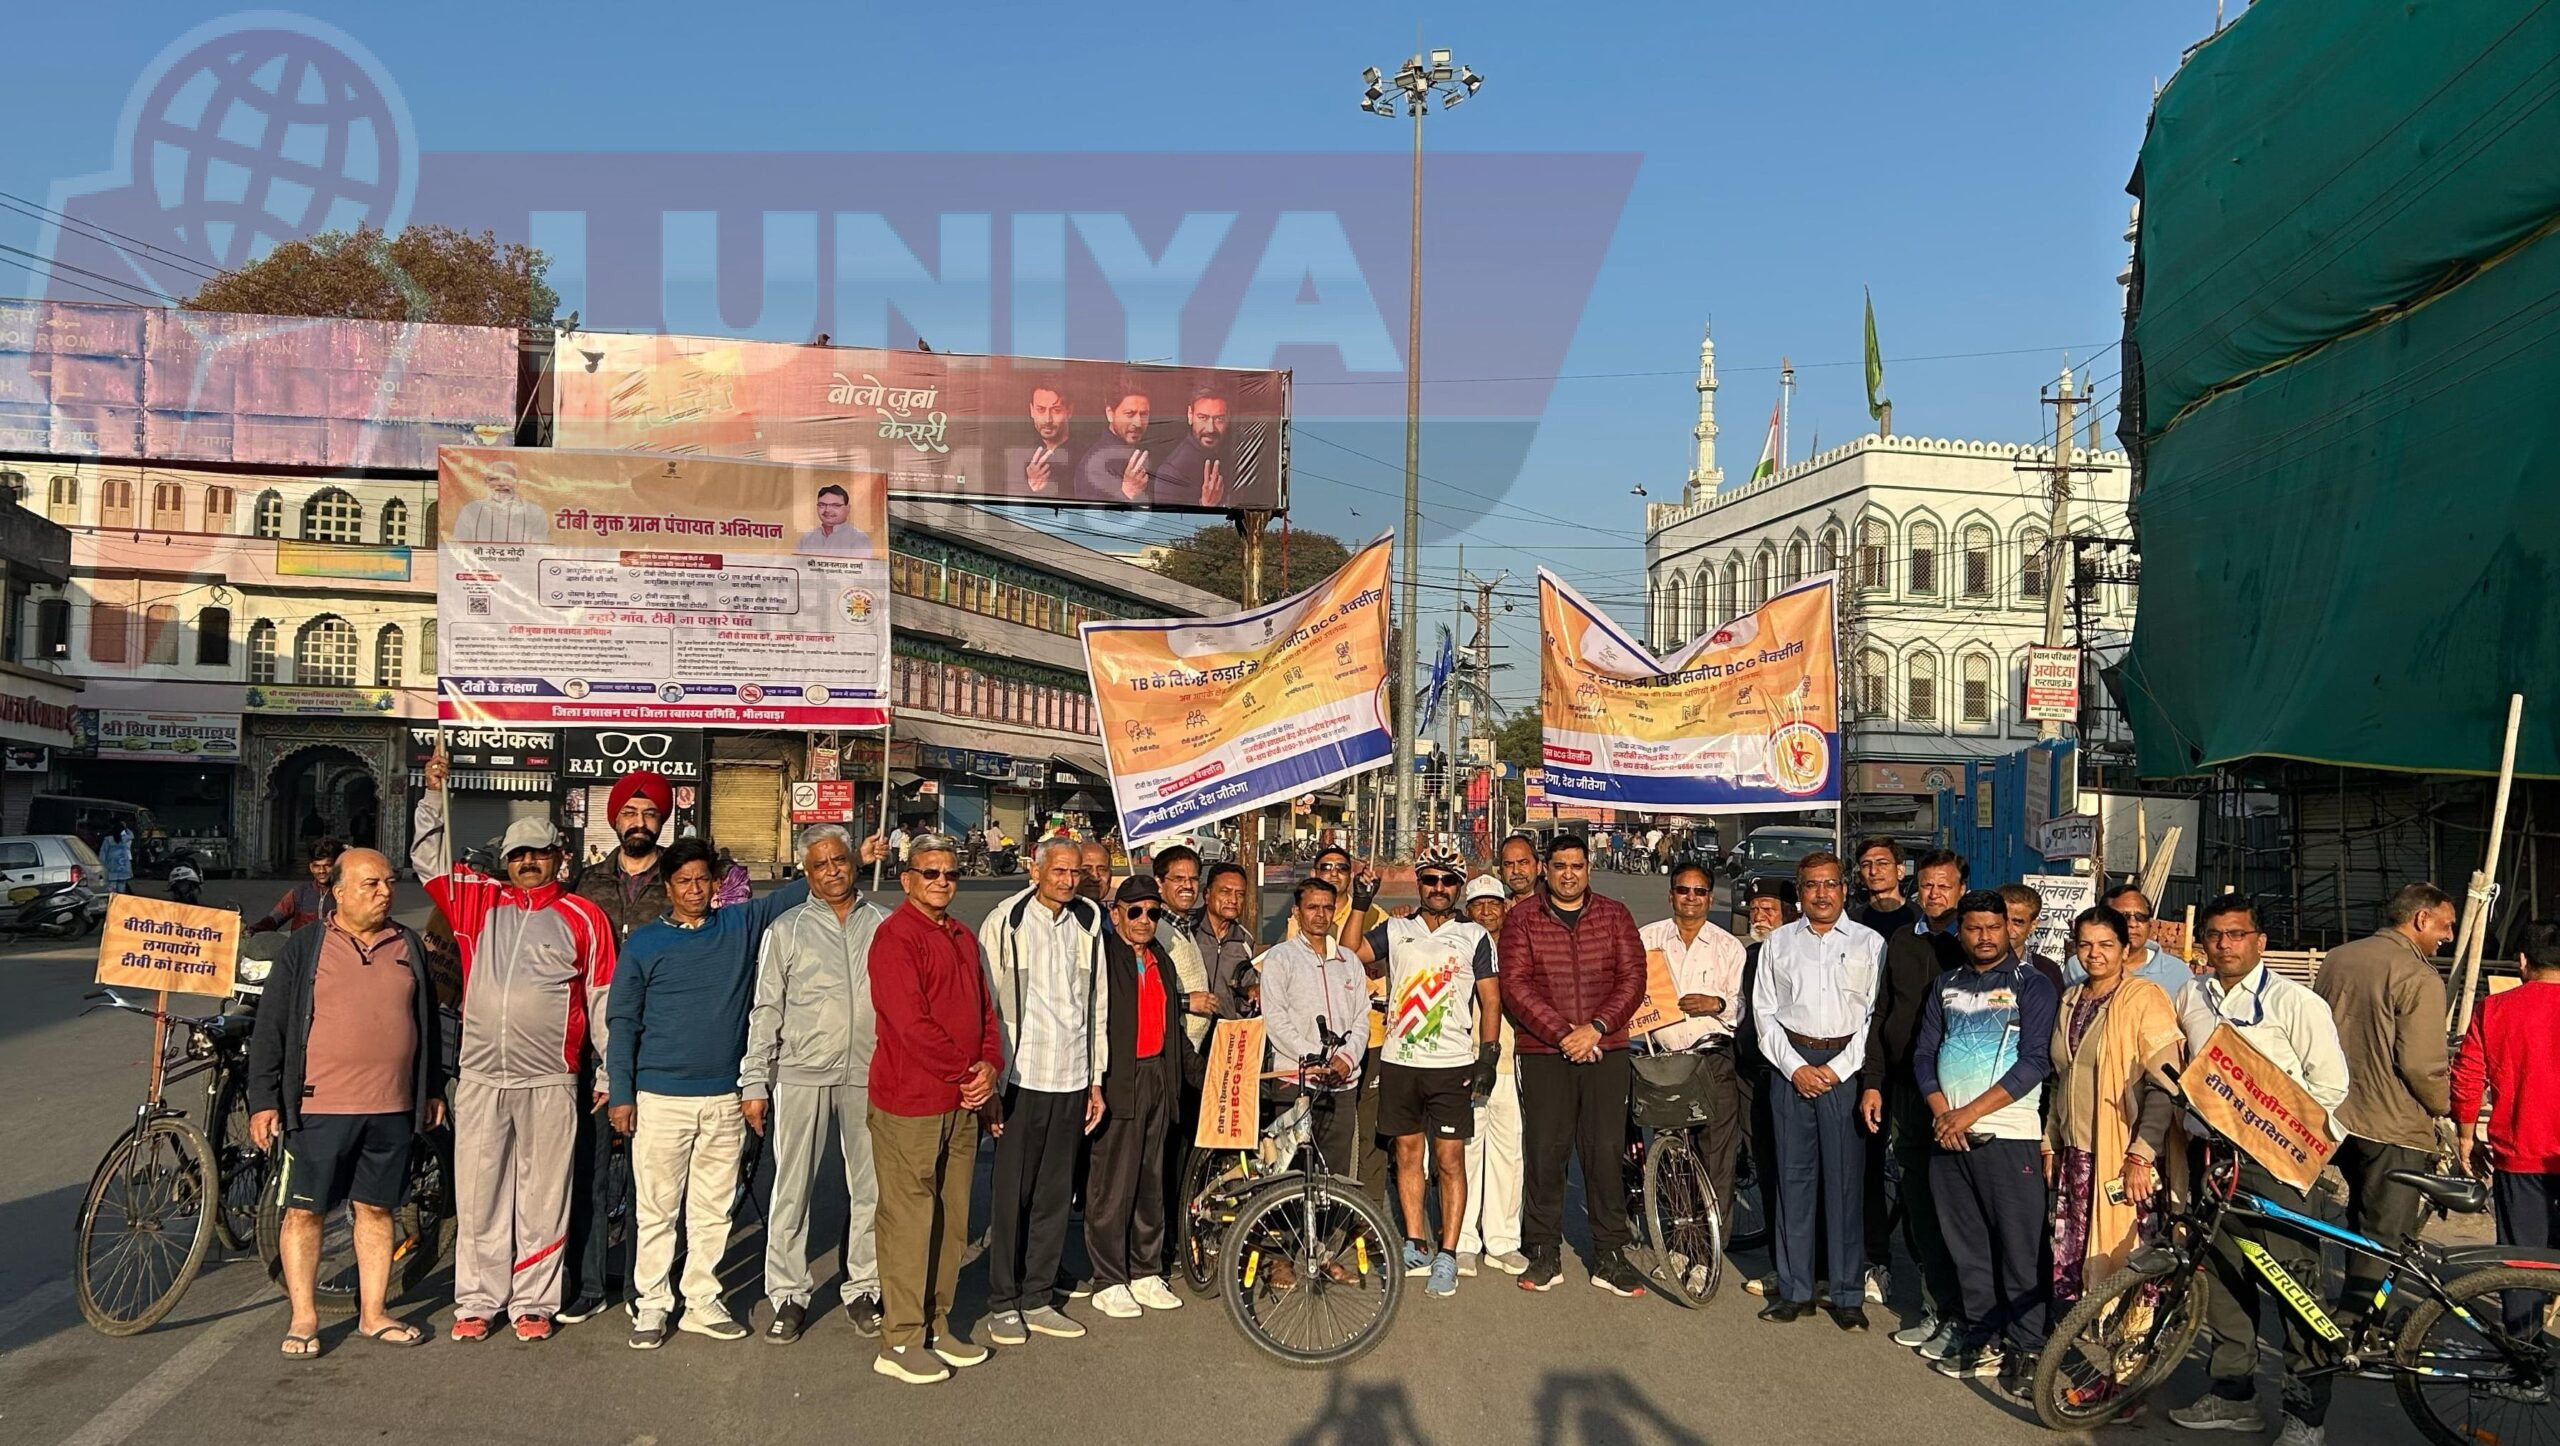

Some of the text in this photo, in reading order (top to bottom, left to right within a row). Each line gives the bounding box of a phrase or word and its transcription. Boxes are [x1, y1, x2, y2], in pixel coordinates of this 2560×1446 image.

[37, 335, 94, 349] ROOM
[828, 373, 939, 417] बोलो जुबां
[876, 408, 949, 453] केसरी
[555, 508, 784, 539] टीबी मुक्त ग्राम पंचायत अभियान
[1131, 678, 1148, 691] TB
[1152, 672, 1166, 689] के
[1211, 661, 1245, 686] लड़ाई
[1310, 613, 1339, 635] BCG
[1339, 588, 1383, 616] वैक्सीन
[1726, 658, 1756, 675] BCG
[1759, 639, 1804, 664] वैक्सीन
[2032, 661, 2076, 679] अयोध्या
[461, 679, 538, 694] टीबी के लक्षण
[552, 704, 785, 722] जिला प्रशासन एवं जिला स्वास्थ्य समिति, भीलवाड़ा
[101, 720, 237, 740] श्री शिव भोजनालय
[569, 758, 697, 777] RAJ OPTICAL
[1544, 771, 1561, 787] रेगा,
[1562, 773, 1575, 787] देश
[1576, 773, 1606, 792] जीतेगा
[1169, 797, 1199, 820] हारेगा,
[1199, 790, 1216, 806] देश
[1216, 780, 1249, 804] जीतेगा
[124, 917, 173, 936] बीसीजी
[143, 940, 201, 957] लगवायेंगे
[122, 953, 217, 976] टीबी को हरायेंगे
[1231, 1073, 1241, 1108] BCG
[2208, 1045, 2244, 1081] BCG
[2243, 1073, 2290, 1121] वैक्सीन
[2205, 1073, 2234, 1101] टीबी
[2234, 1098, 2246, 1113] से
[2243, 1108, 2291, 1150] सुरक्षित
[2254, 1251, 2337, 1340] HERCULES
